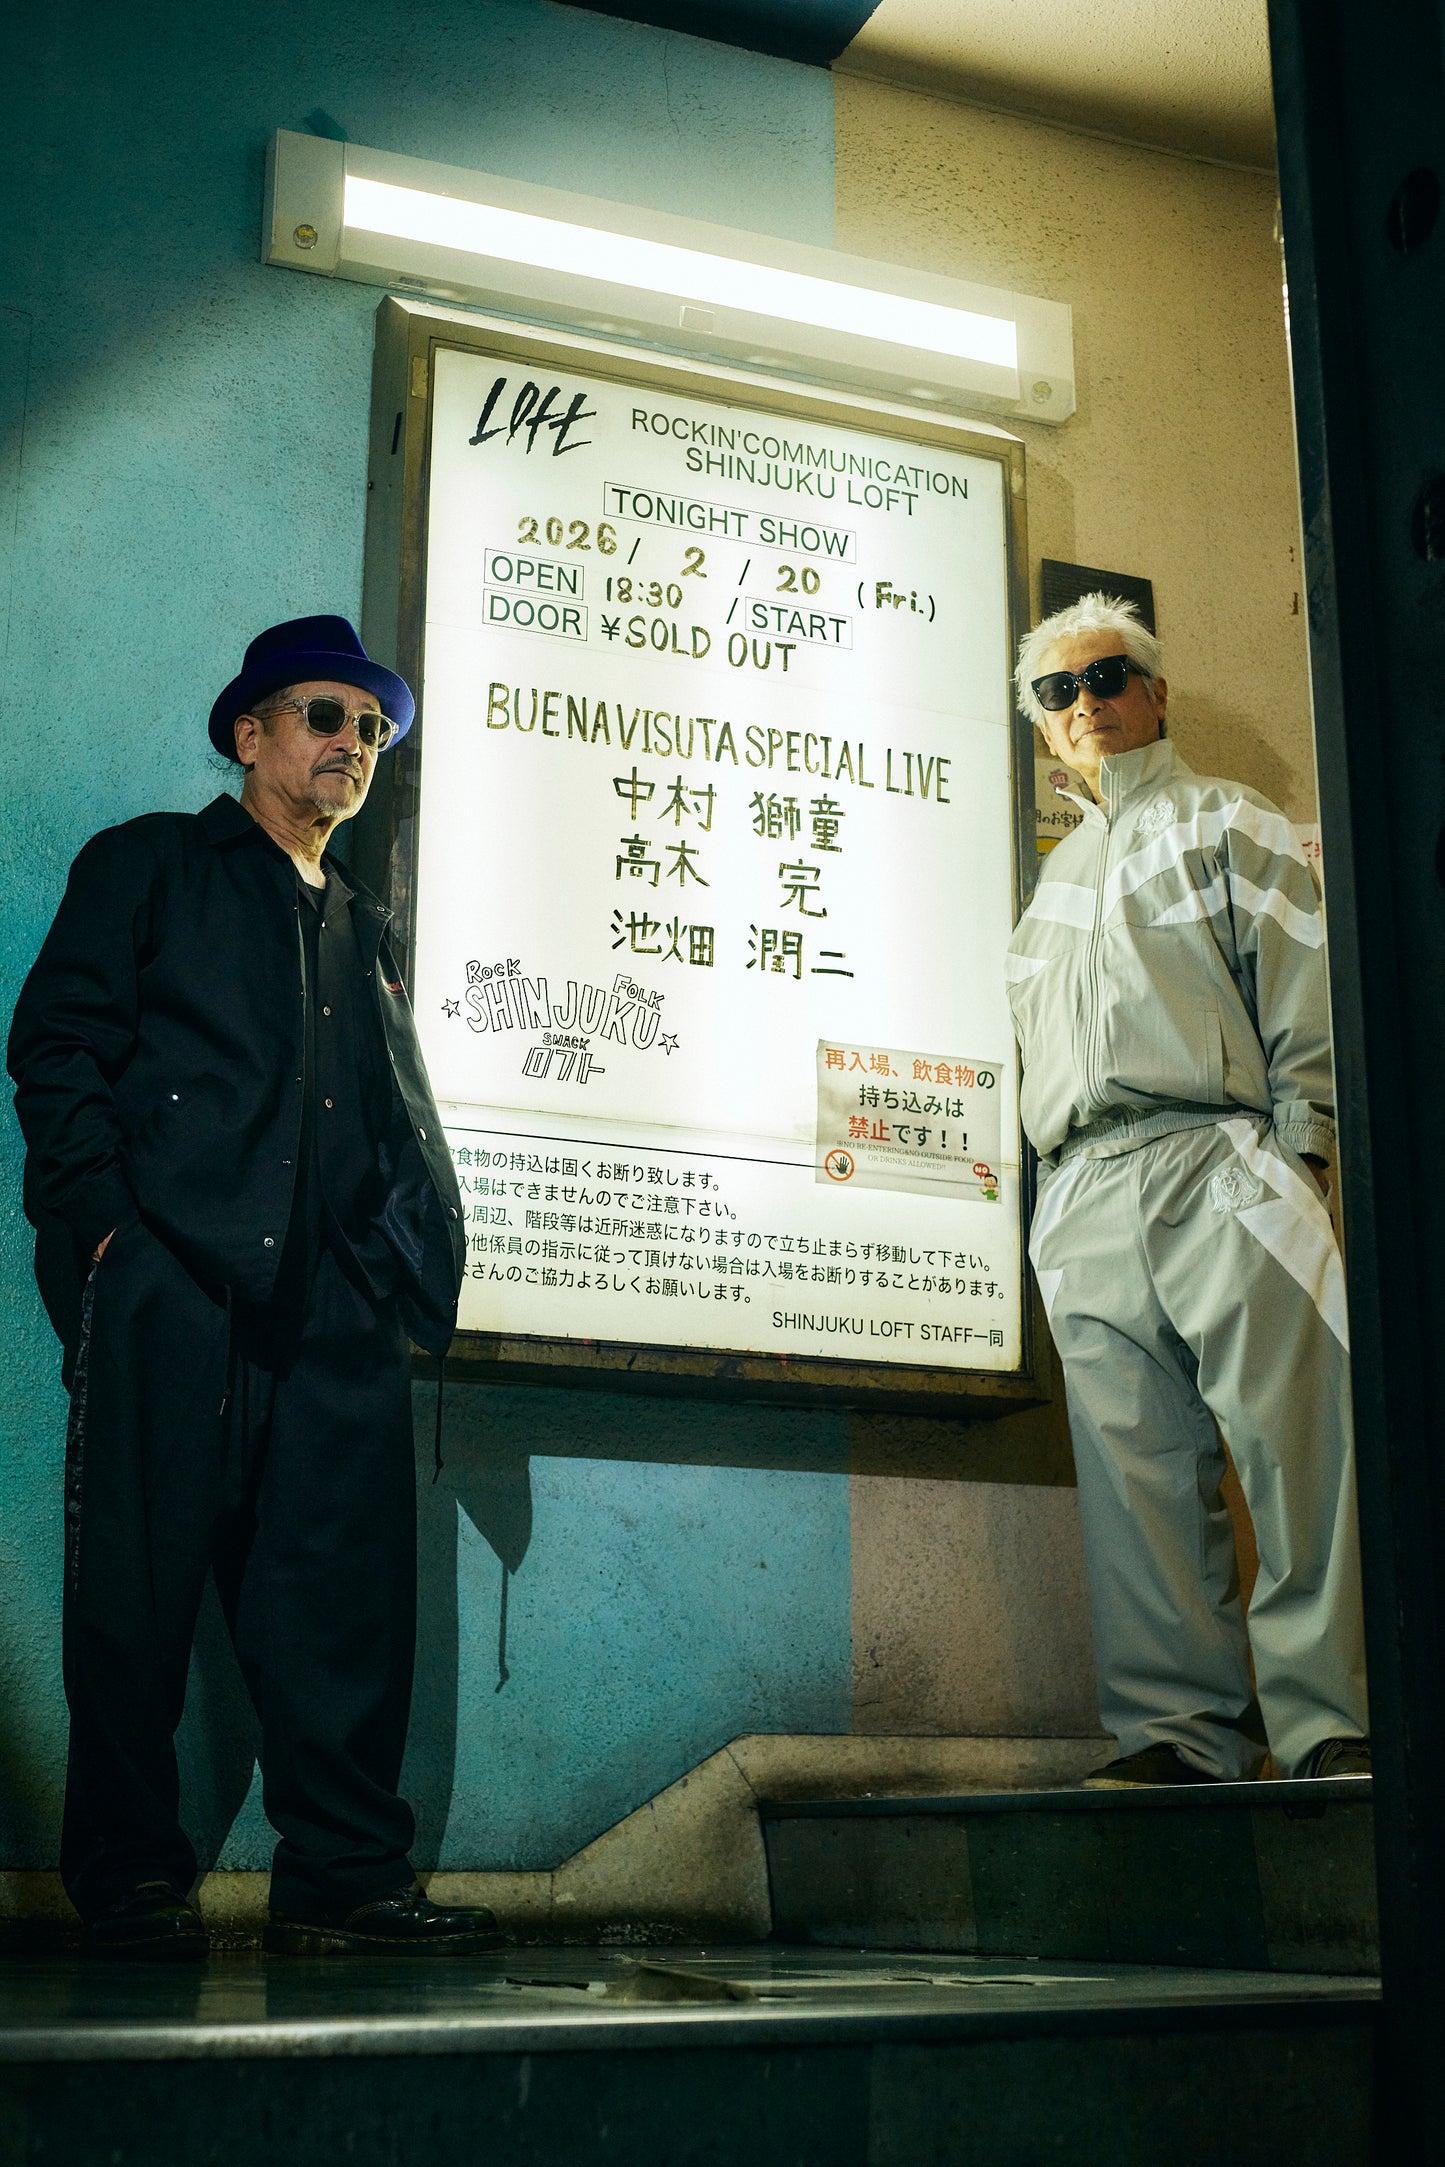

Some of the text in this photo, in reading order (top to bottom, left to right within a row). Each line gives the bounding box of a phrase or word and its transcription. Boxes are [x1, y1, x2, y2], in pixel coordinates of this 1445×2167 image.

[632, 408, 968, 499] ROCKIN'COMMUNICATION
[685, 447, 919, 516] SHINJUKU LOFT
[517, 516, 617, 556] 2026
[681, 547, 707, 579] 2
[777, 565, 820, 595] 20
[611, 488, 849, 558] TONIGHT SHOW
[488, 595, 582, 636] DOOR
[728, 632, 797, 672] OUT
[491, 555, 578, 595] OPEN
[606, 576, 683, 609] 18:30
[751, 603, 847, 644] START
[745, 725, 875, 788] SPECIAL
[886, 749, 951, 803] LIVE
[612, 766, 846, 853] 中村 獅童
[615, 833, 828, 918] 高木 完
[610, 908, 854, 980] 池畑 潤二
[465, 978, 661, 1050] SHINJUKU
[542, 1032, 591, 1051] SNACK
[825, 1048, 995, 1089] 再入場、飲食物の
[859, 1084, 964, 1118] 持ち込みは
[773, 1312, 863, 1334] SHINJUKU
[871, 1321, 915, 1338] LOFT
